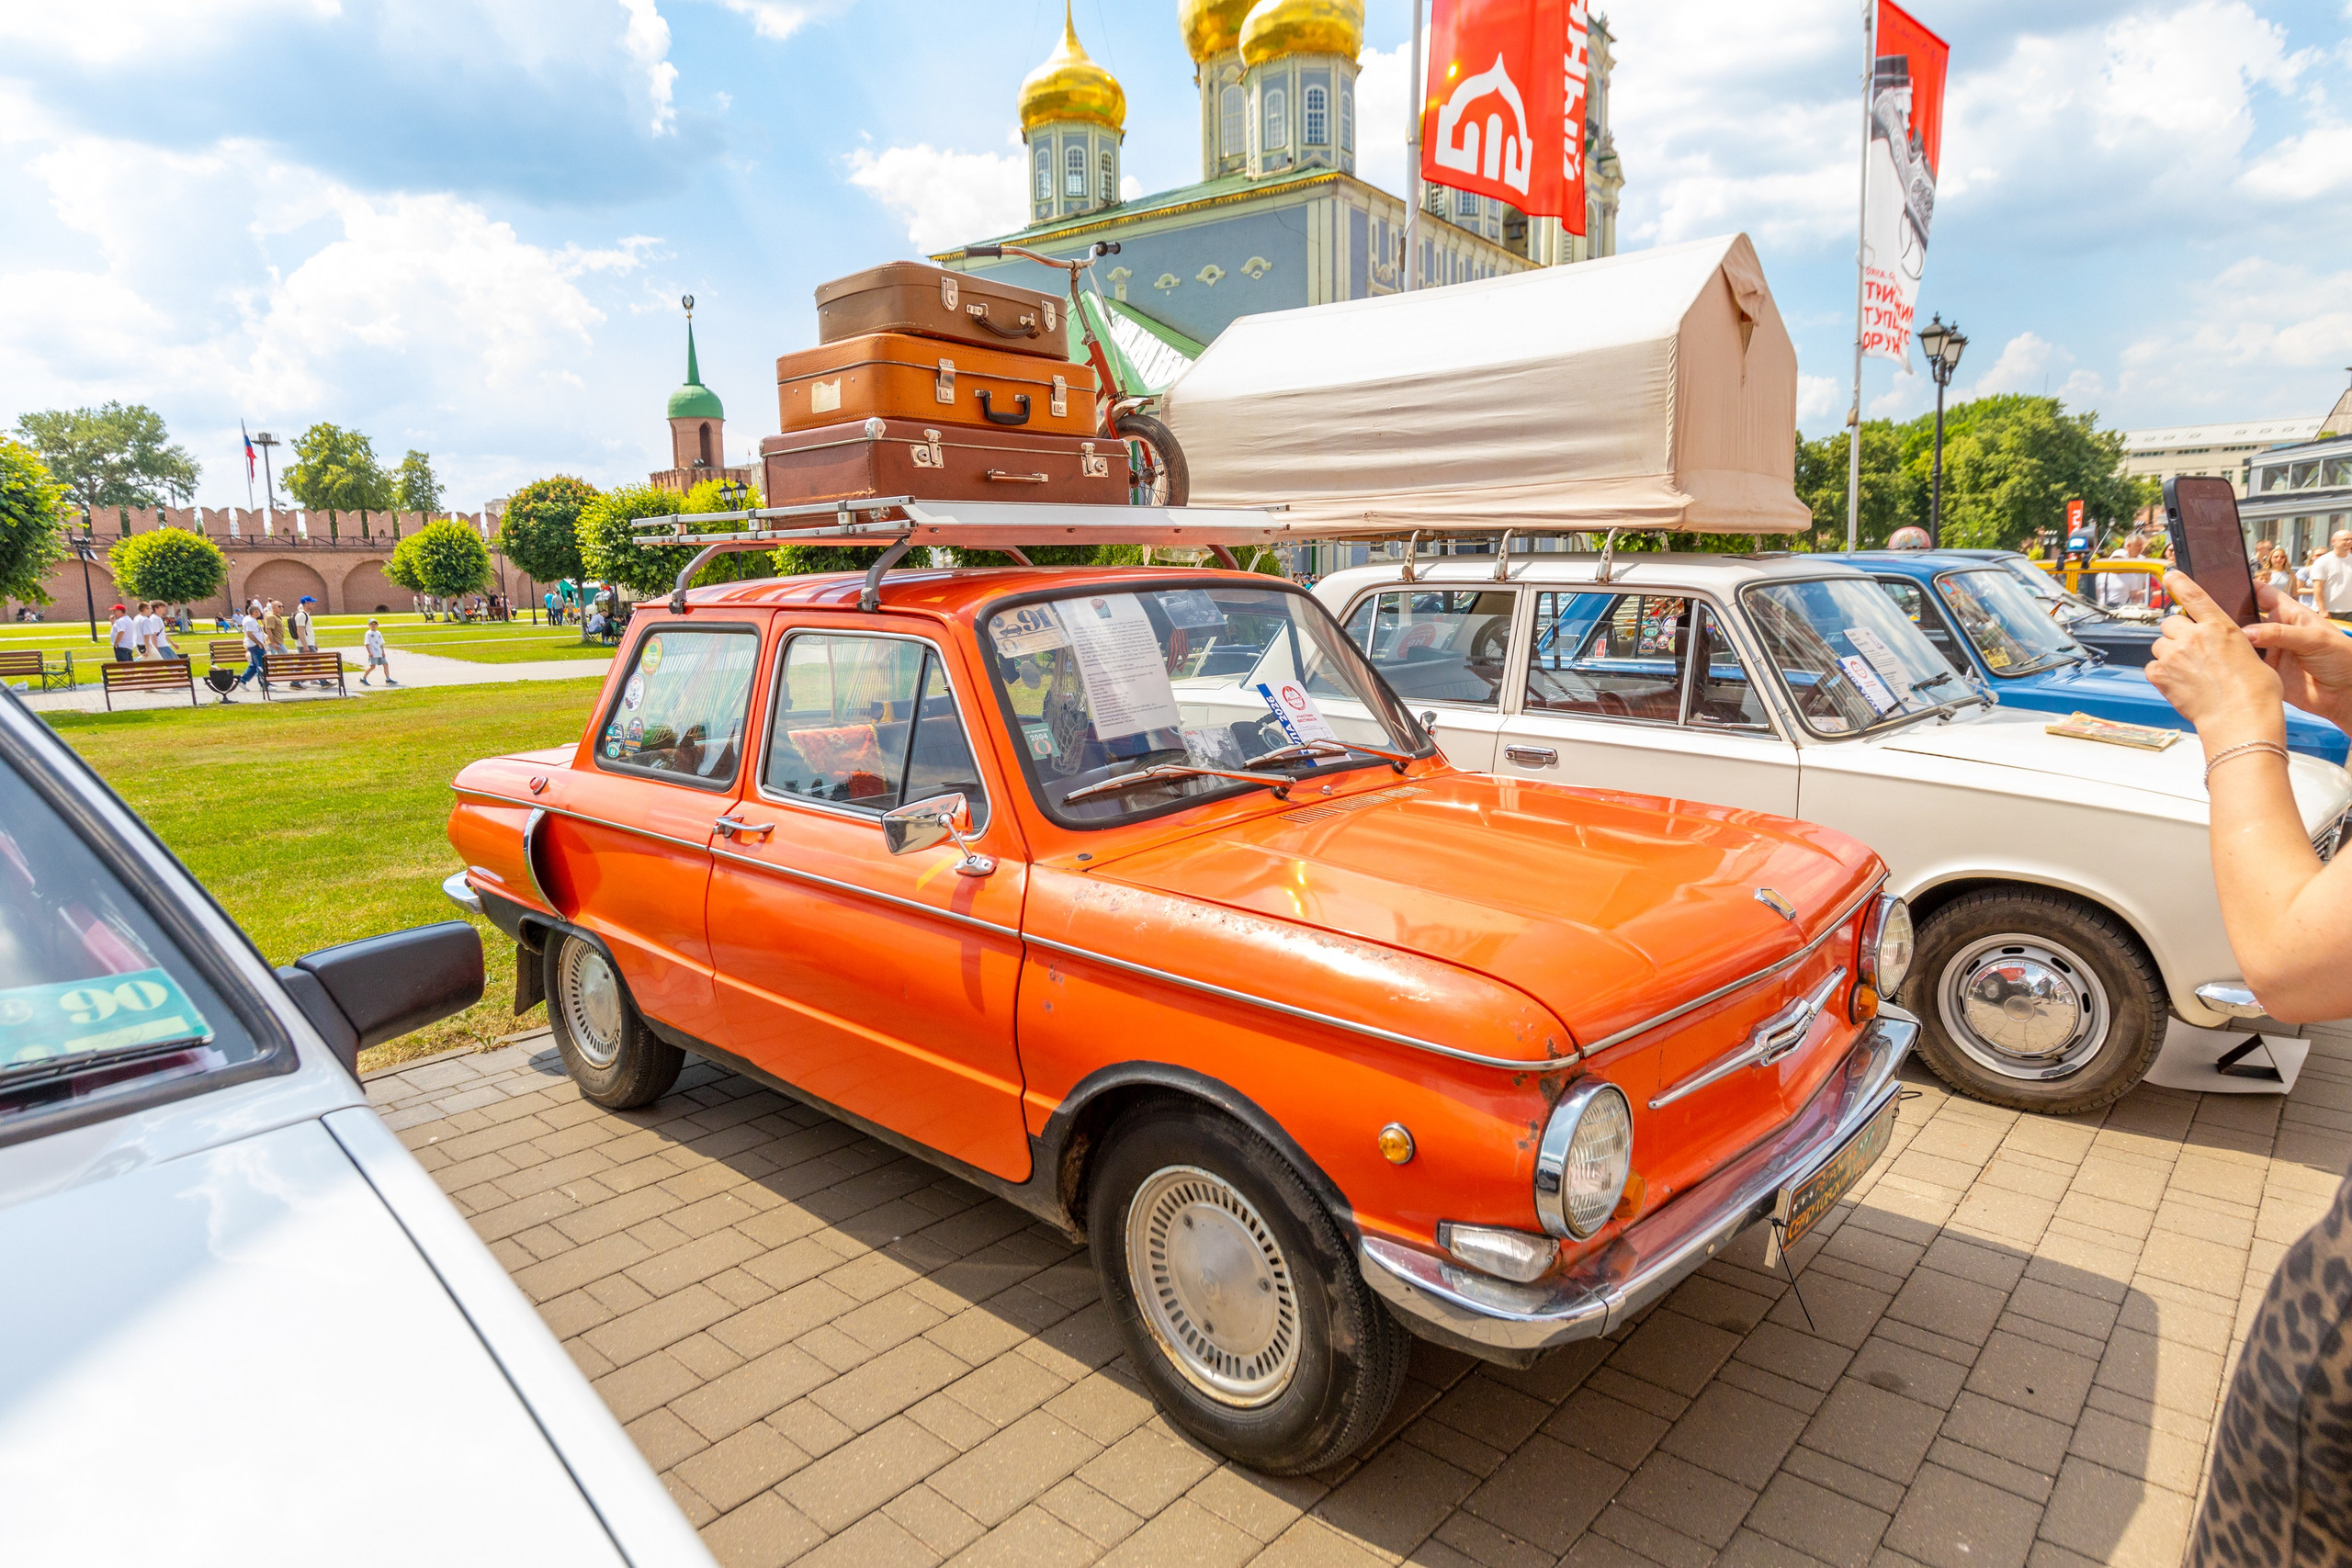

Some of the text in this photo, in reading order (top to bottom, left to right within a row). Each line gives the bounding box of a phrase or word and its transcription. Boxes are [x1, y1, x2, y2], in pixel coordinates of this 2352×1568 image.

[1017, 606, 1054, 631] 91
[1266, 695, 1288, 722] 2026
[1029, 733, 1049, 741] 2004
[59, 980, 168, 1024] 90
